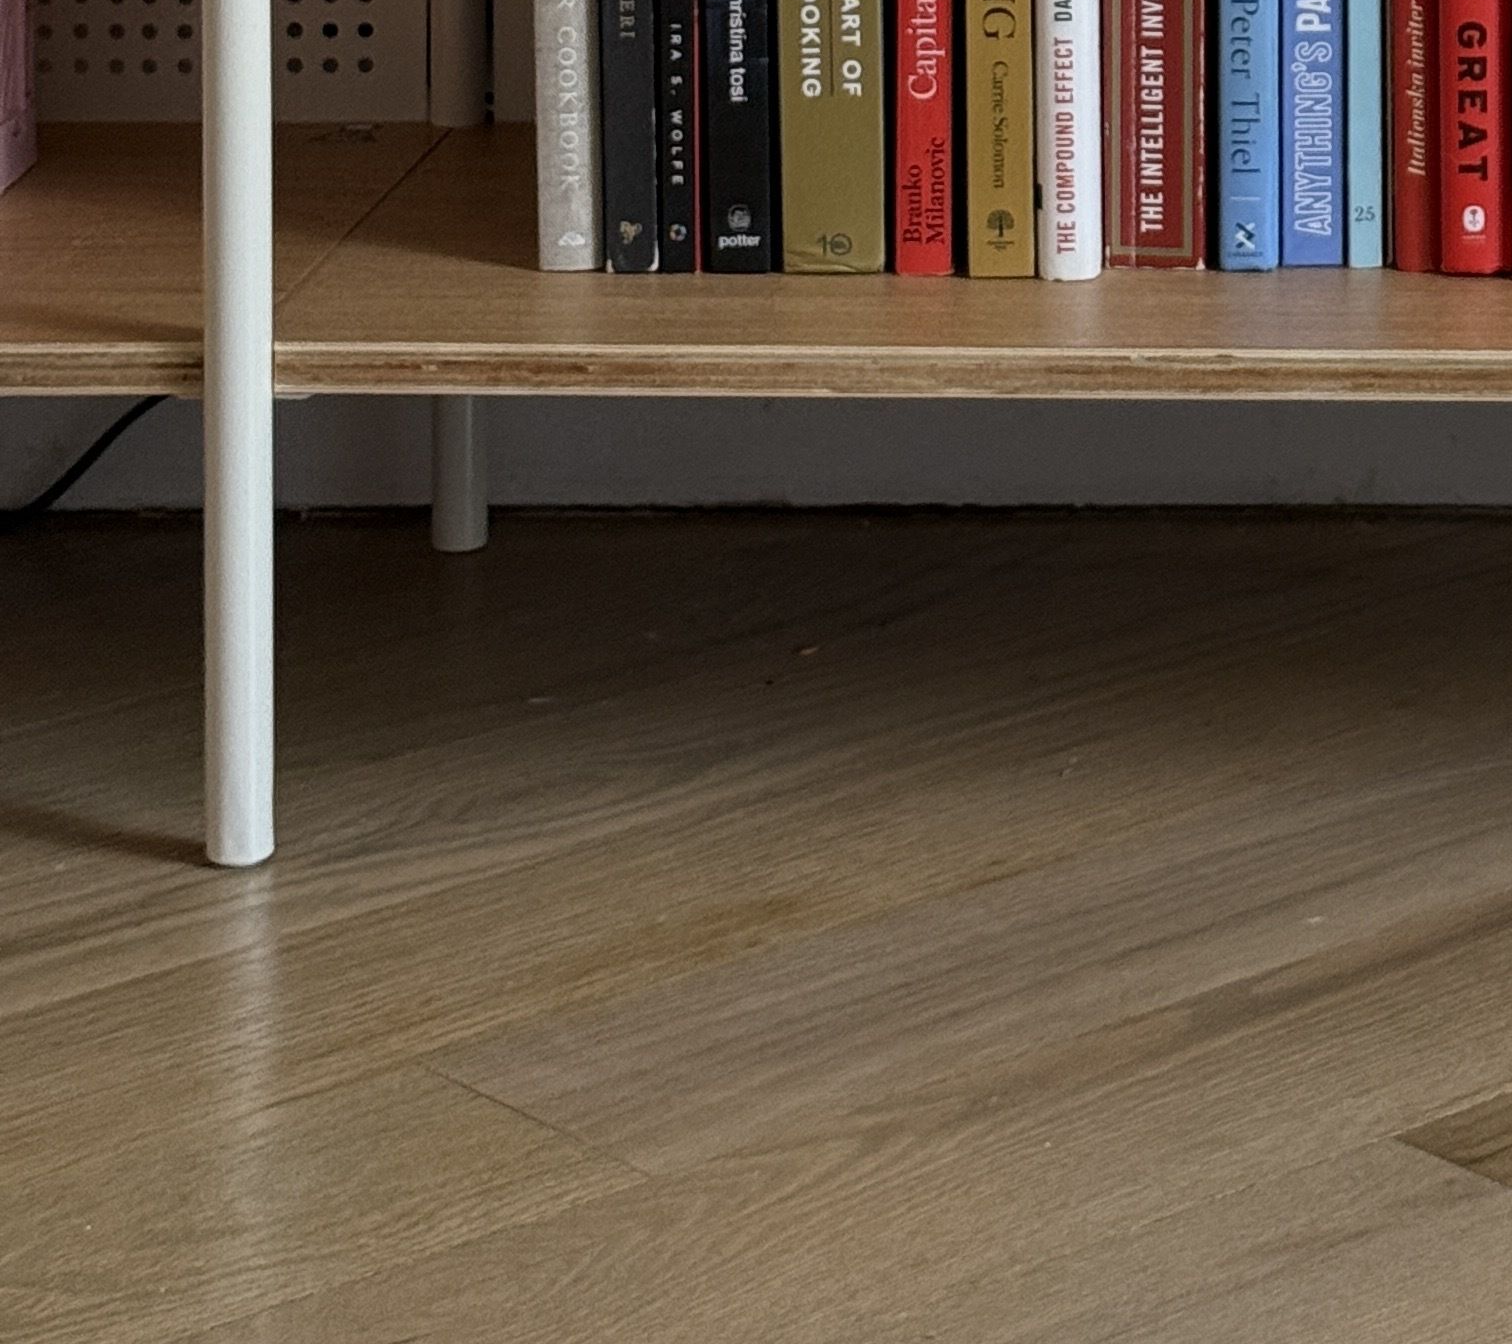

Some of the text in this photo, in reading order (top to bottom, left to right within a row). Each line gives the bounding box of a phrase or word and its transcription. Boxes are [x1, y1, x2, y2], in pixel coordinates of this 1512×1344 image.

[670, 23, 682, 62] IRA
[842, 60, 862, 97] OF
[557, 26, 580, 191] COOKBOOK
[729, 67, 748, 102] tosi
[1141, 46, 1164, 187] INTELLIGENT
[1457, 21, 1489, 181] GREAT
[670, 110, 684, 185] WOLFE
[991, 61, 1009, 189] Carrie Solomon
[1054, 38, 1076, 255] THE COMPOUND EFFECT
[1230, 93, 1260, 174] Thiel
[718, 234, 760, 251] potter
[903, 165, 921, 244] Branko
[1141, 191, 1163, 233] THE
[1354, 206, 1375, 222] 25
